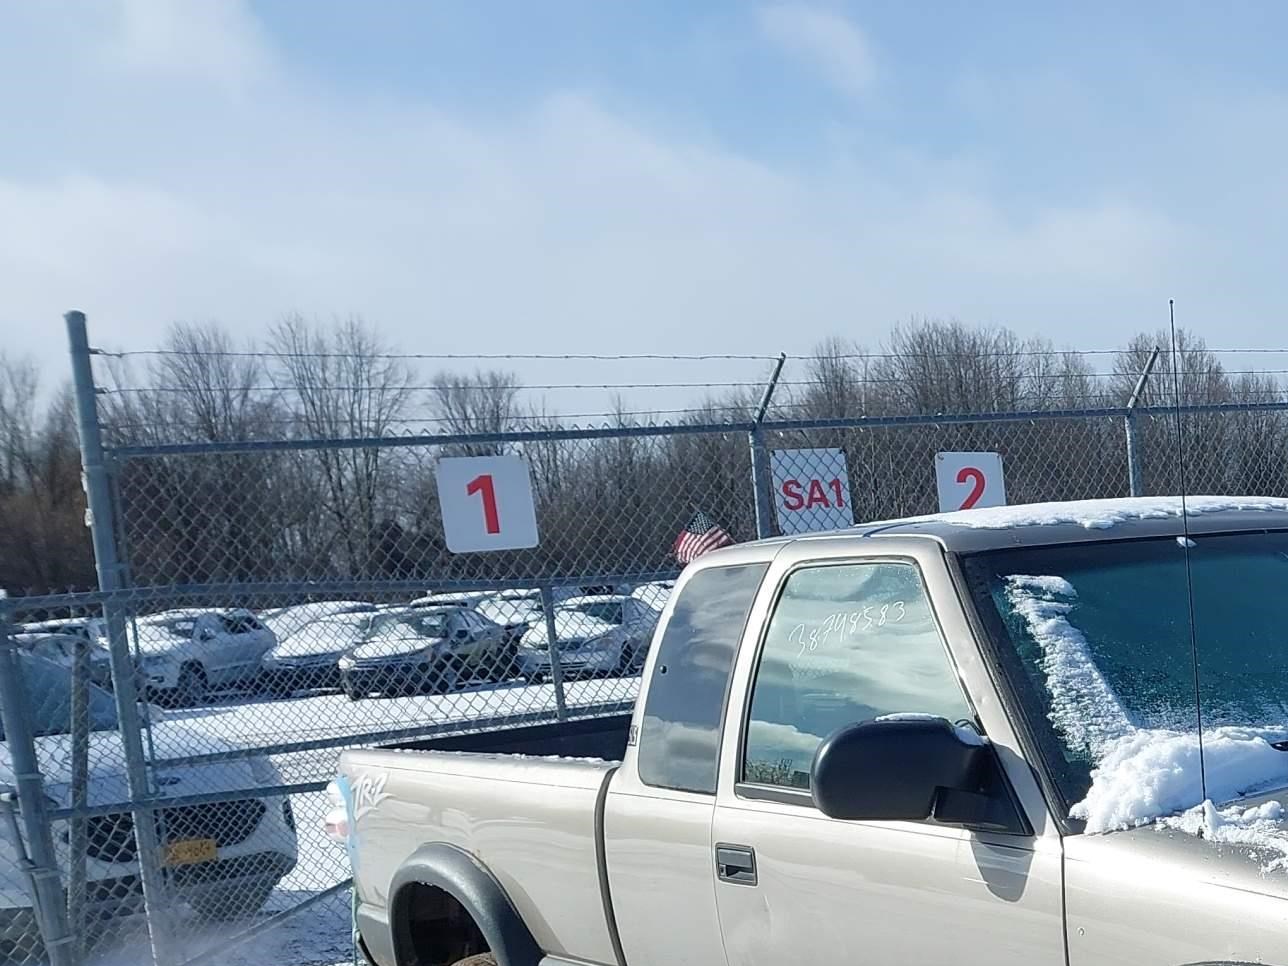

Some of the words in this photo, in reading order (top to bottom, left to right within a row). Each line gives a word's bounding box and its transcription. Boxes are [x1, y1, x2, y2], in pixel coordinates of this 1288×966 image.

[466, 474, 500, 534] 1
[781, 478, 845, 511] SA1
[956, 467, 986, 510] 2
